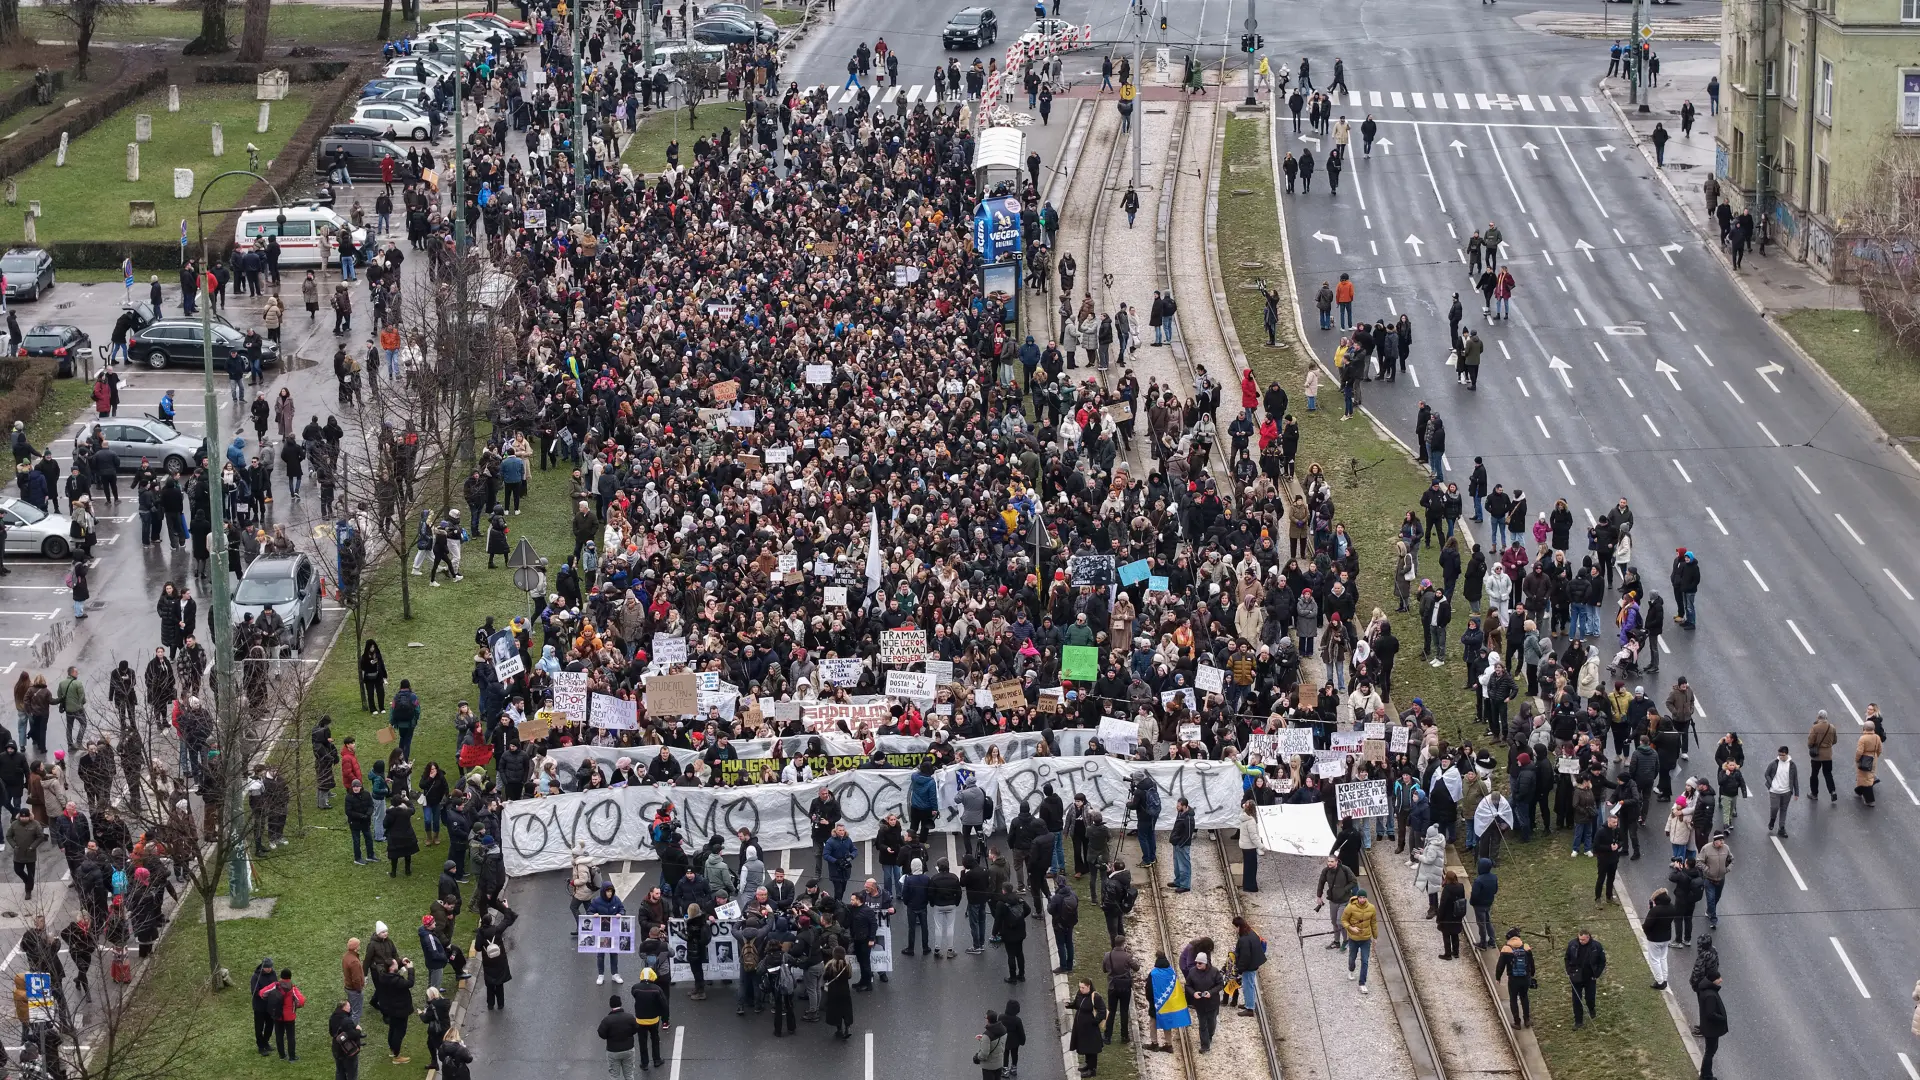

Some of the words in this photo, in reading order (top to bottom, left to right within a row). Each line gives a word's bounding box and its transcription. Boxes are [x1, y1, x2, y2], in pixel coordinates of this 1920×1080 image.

[1125, 87, 1131, 96] 5
[989, 229, 1020, 241] VEGETA
[882, 631, 925, 639] TRAMVAJ
[882, 647, 926, 655] TRAMVAJ
[498, 658, 518, 671] PRAVDA
[882, 655, 892, 663] JE
[554, 677, 587, 686] NEPRAVDA
[559, 672, 581, 680] KADA
[890, 672, 916, 680] IZGOVORA
[569, 685, 587, 693] ZAKON
[649, 681, 684, 692] STUDENTI
[889, 687, 909, 695] OSTAVKE
[554, 694, 586, 703] OTPOR
[805, 705, 849, 719] SADA
[721, 757, 780, 773] HULIGANI
[833, 753, 936, 769] DOSTANSTVO
[1338, 784, 1349, 793] KO
[1356, 781, 1373, 790] REKO
[1339, 792, 1348, 802] DA
[1349, 791, 1356, 800] SE
[1339, 798, 1375, 810] MINISTRICA
[1340, 806, 1368, 819] OSTAVKU
[509, 797, 622, 859] OVO
[637, 796, 760, 851] SMO
[31, 977, 45, 995] P
